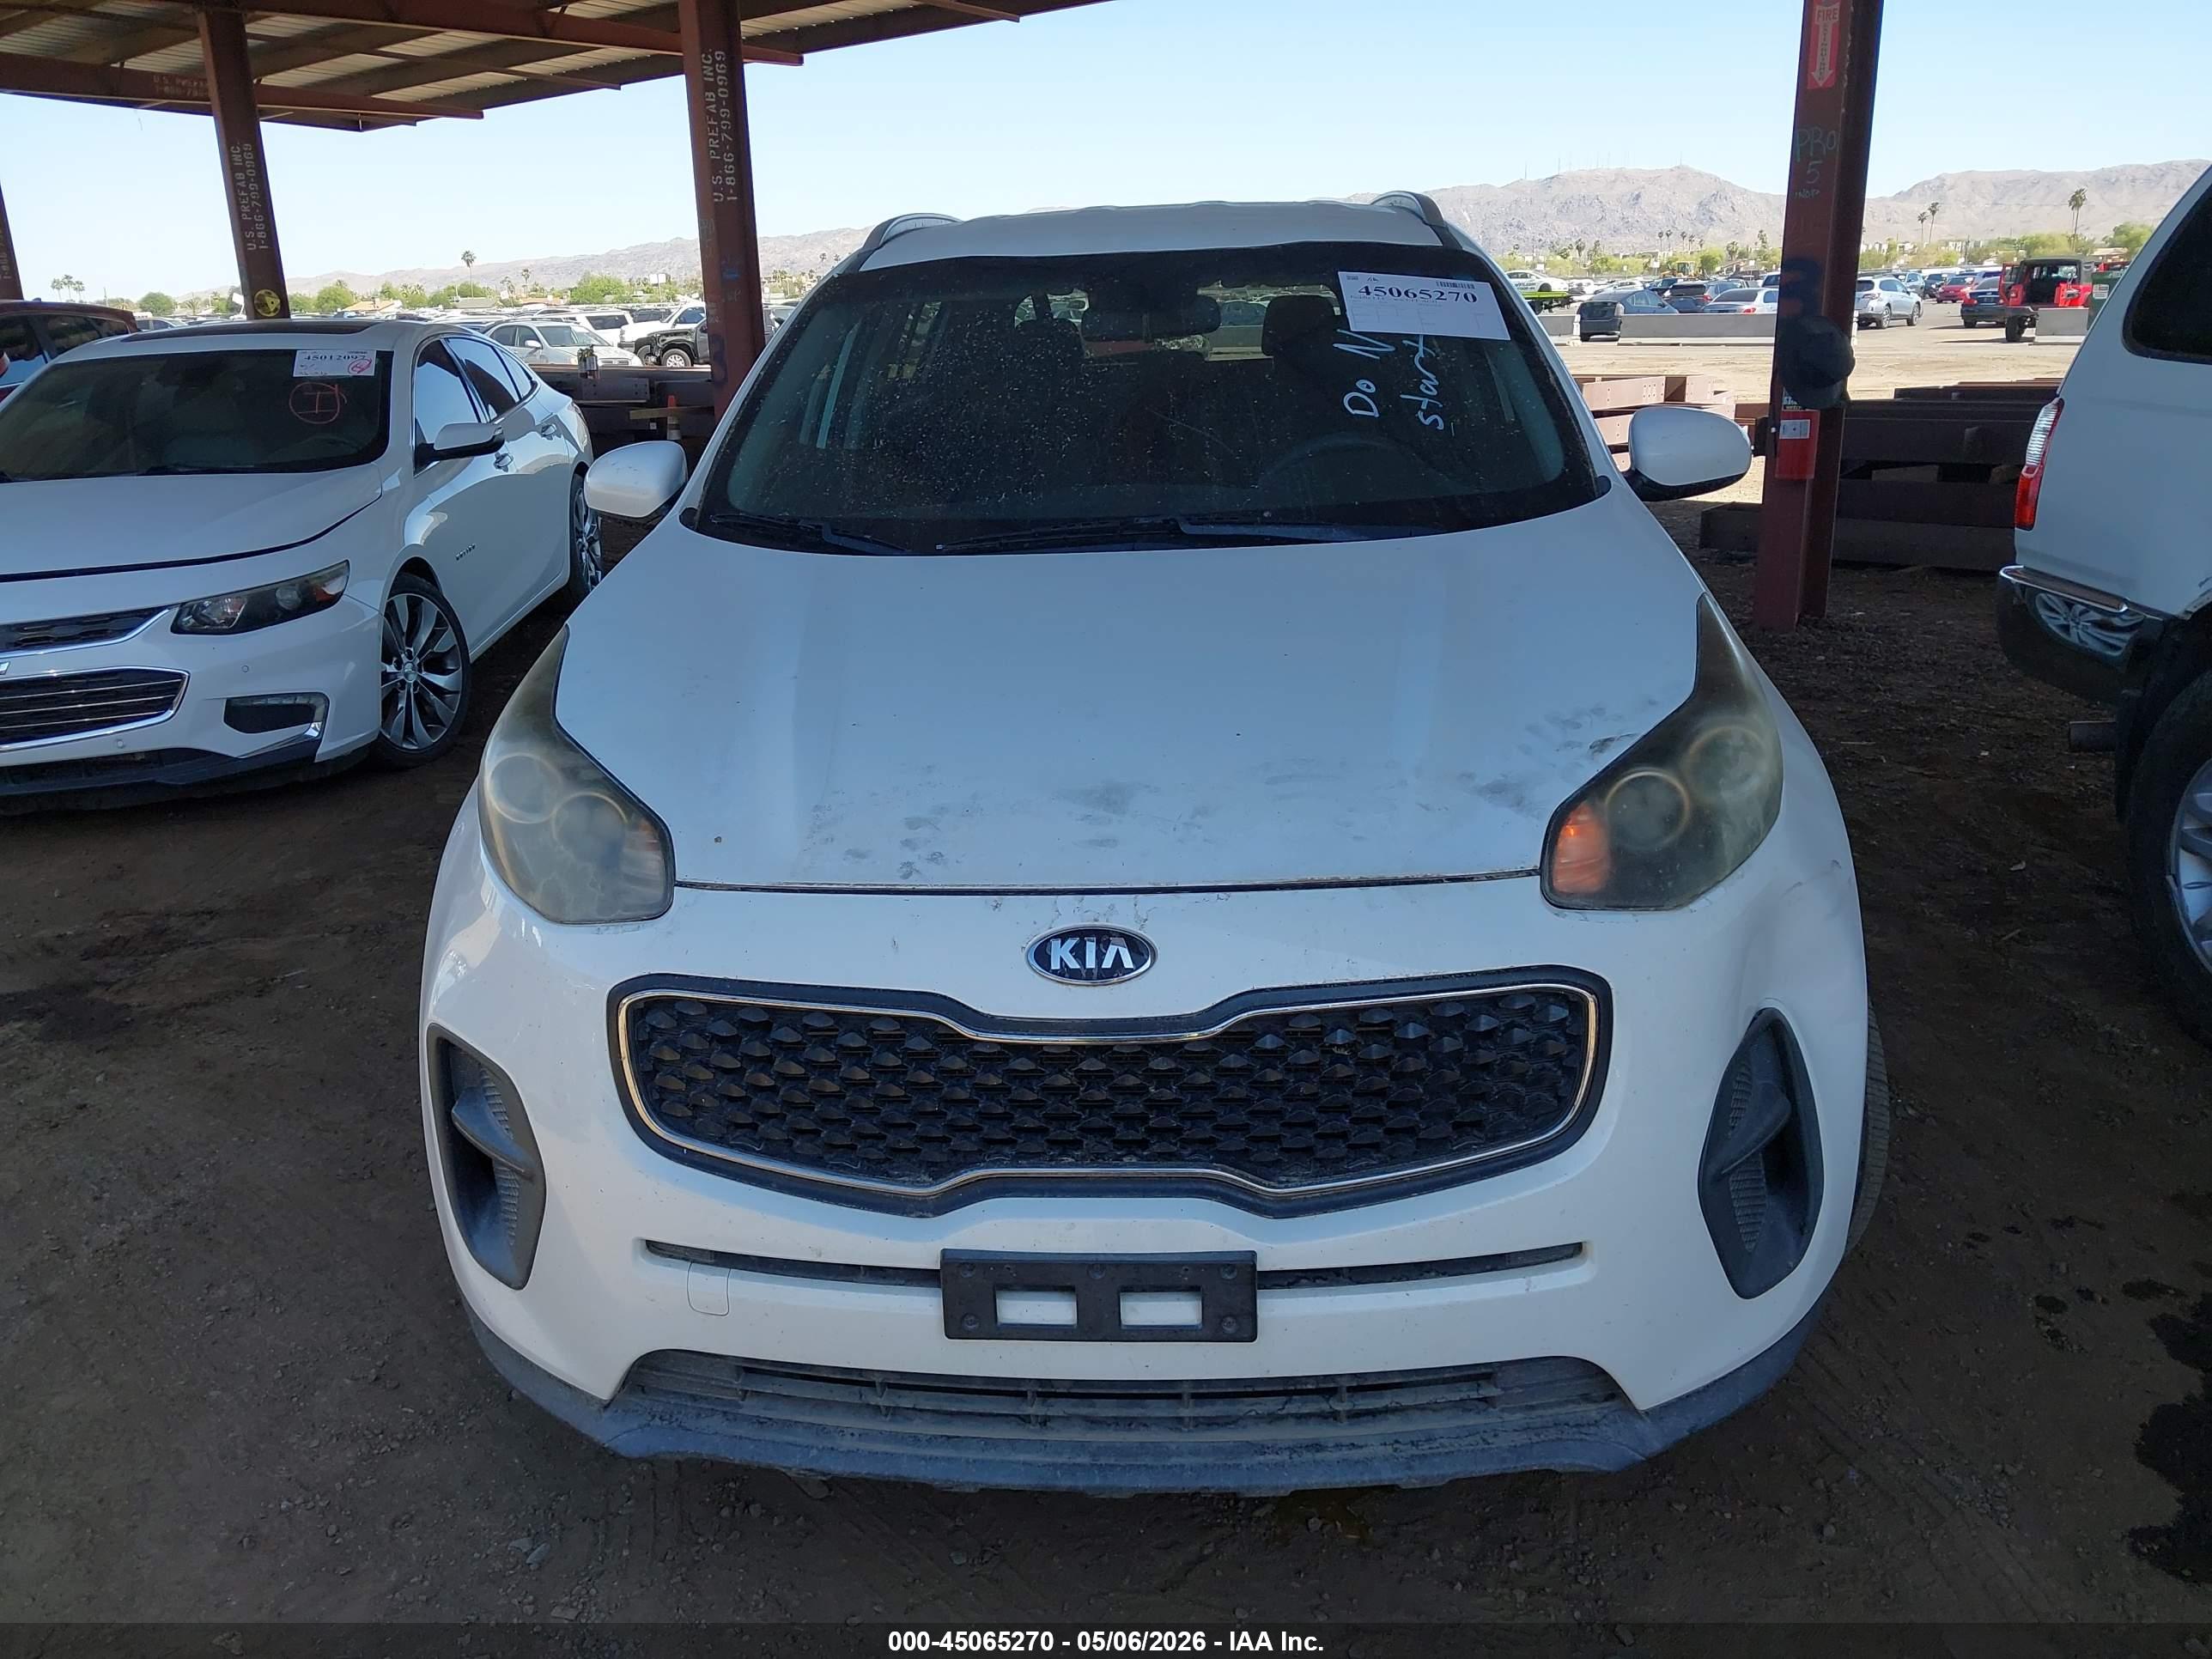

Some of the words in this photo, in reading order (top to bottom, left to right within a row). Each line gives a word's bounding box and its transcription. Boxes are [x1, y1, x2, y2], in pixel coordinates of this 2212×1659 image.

[1817, 8, 1838, 21] FIRE
[701, 48, 714, 82] INC.
[705, 91, 720, 160] PREFAB
[714, 51, 738, 202] 1-866-799-0969
[230, 142, 243, 166] INC.
[234, 172, 252, 220] PREFAB
[712, 170, 725, 203] U.S.
[245, 227, 257, 251] U.S.
[1358, 284, 1477, 303] 45065270
[1343, 380, 1380, 418] Do
[1049, 937, 1134, 970] KIA
